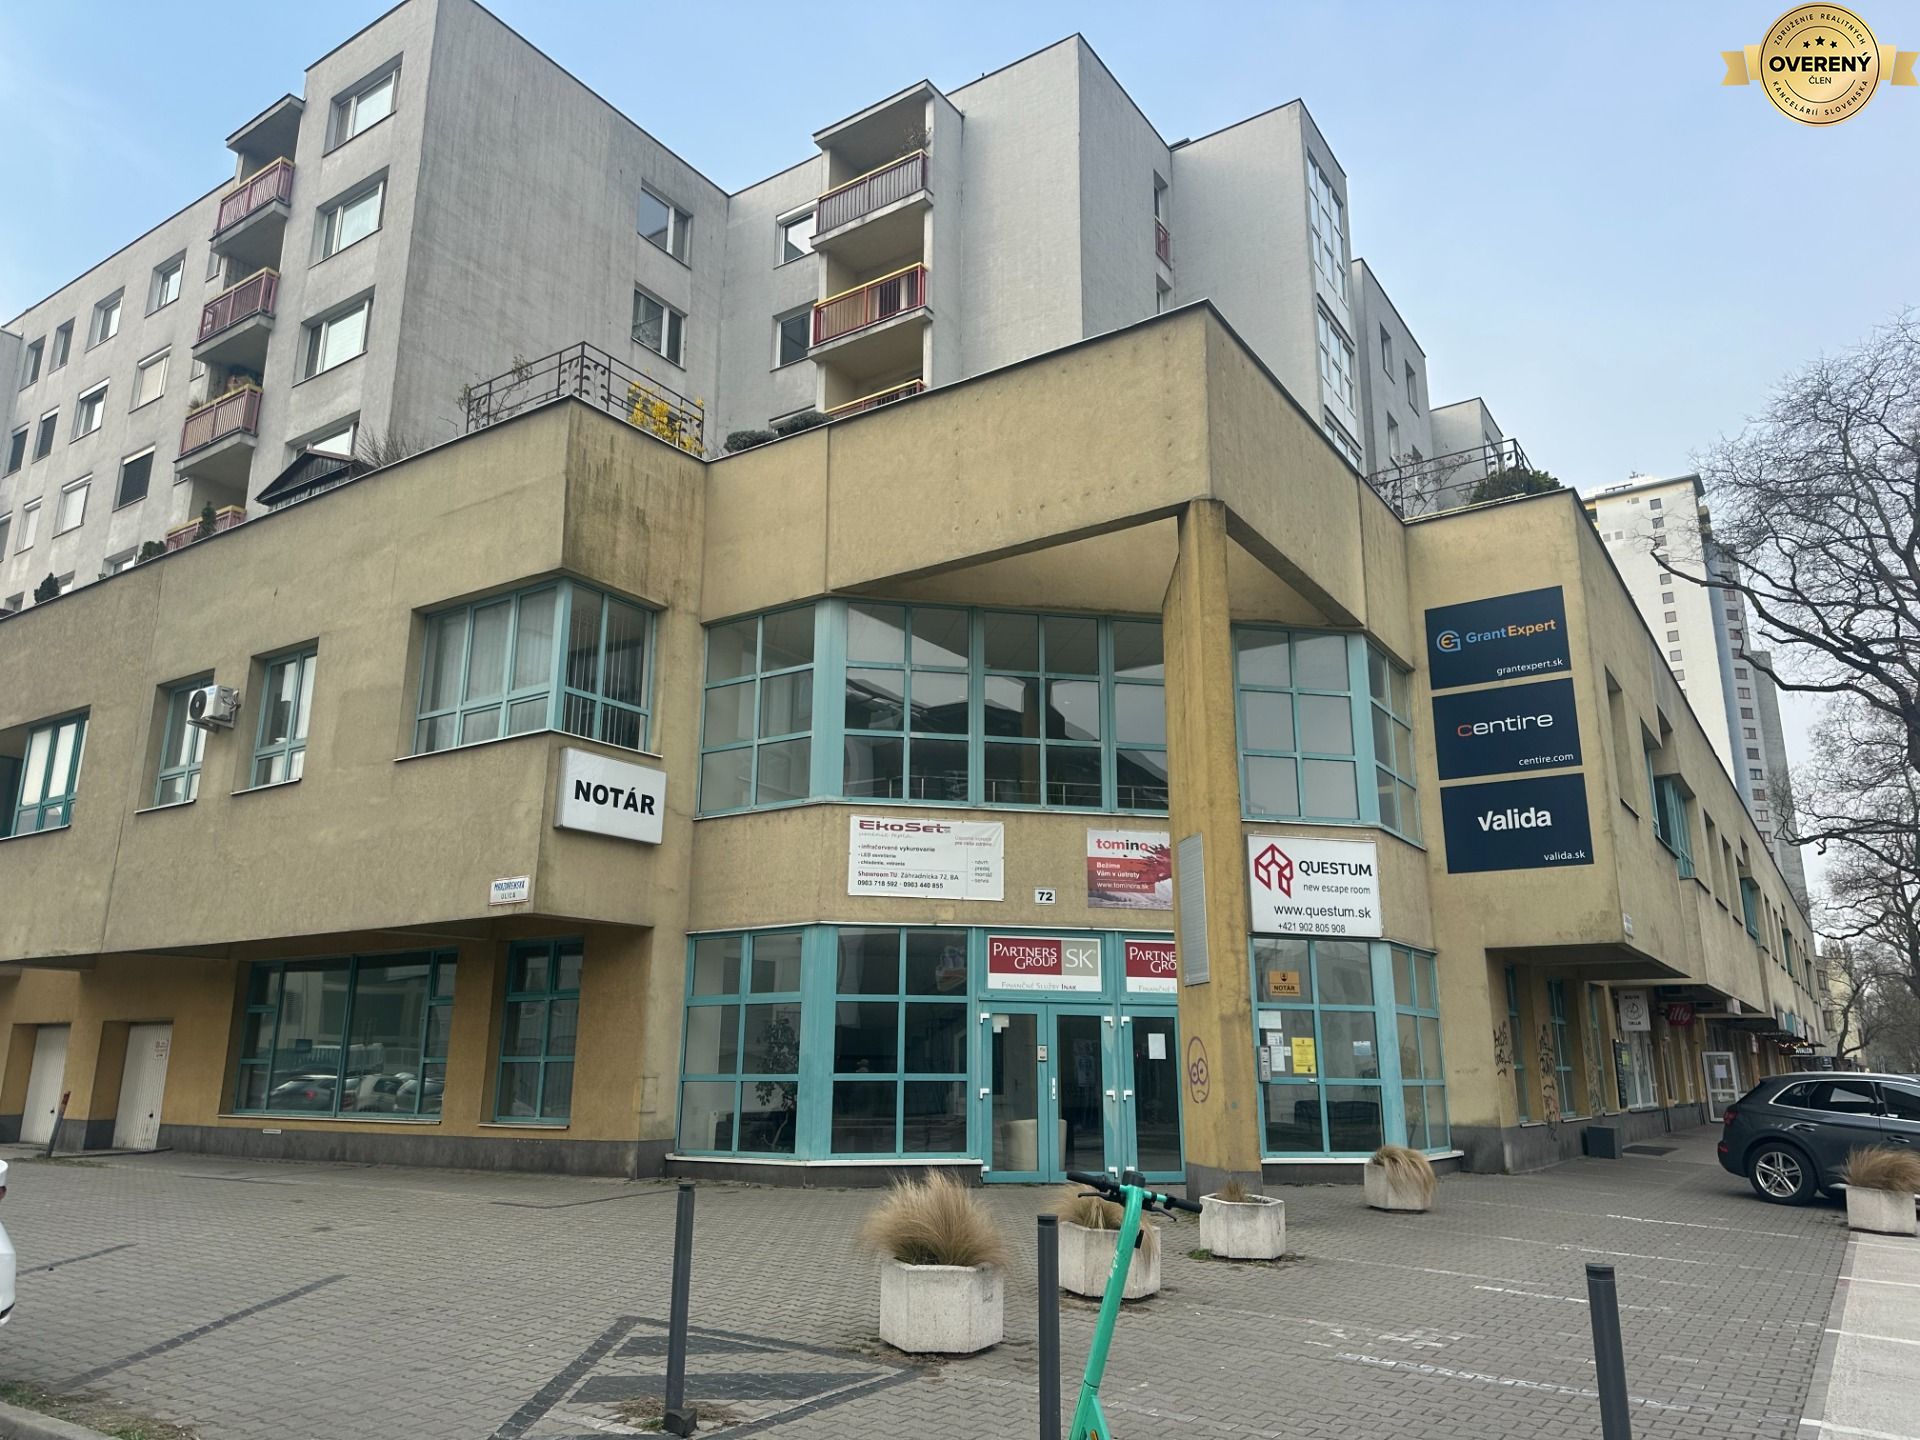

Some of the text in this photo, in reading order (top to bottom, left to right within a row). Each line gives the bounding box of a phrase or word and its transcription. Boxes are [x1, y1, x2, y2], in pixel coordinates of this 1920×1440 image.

[1496, 657, 1563, 676] grantexpert.sk
[1457, 713, 1554, 737] centire
[1518, 753, 1574, 766] centire.com
[574, 779, 656, 815] NOTÁR
[1478, 807, 1552, 832] Valida
[1543, 849, 1586, 862] valida.sk
[1298, 860, 1373, 877] QUESTUM
[1038, 891, 1053, 901] 72
[1303, 884, 1371, 894] new escape room
[1274, 905, 1371, 919] www.questum.sk
[1278, 923, 1346, 933] +421 902 805 908
[993, 942, 1057, 958] PARTNERS
[1129, 946, 1176, 961] PARTNE
[1014, 956, 1057, 970] GROUP
[1065, 948, 1094, 968] SK
[1150, 960, 1177, 973] GRO
